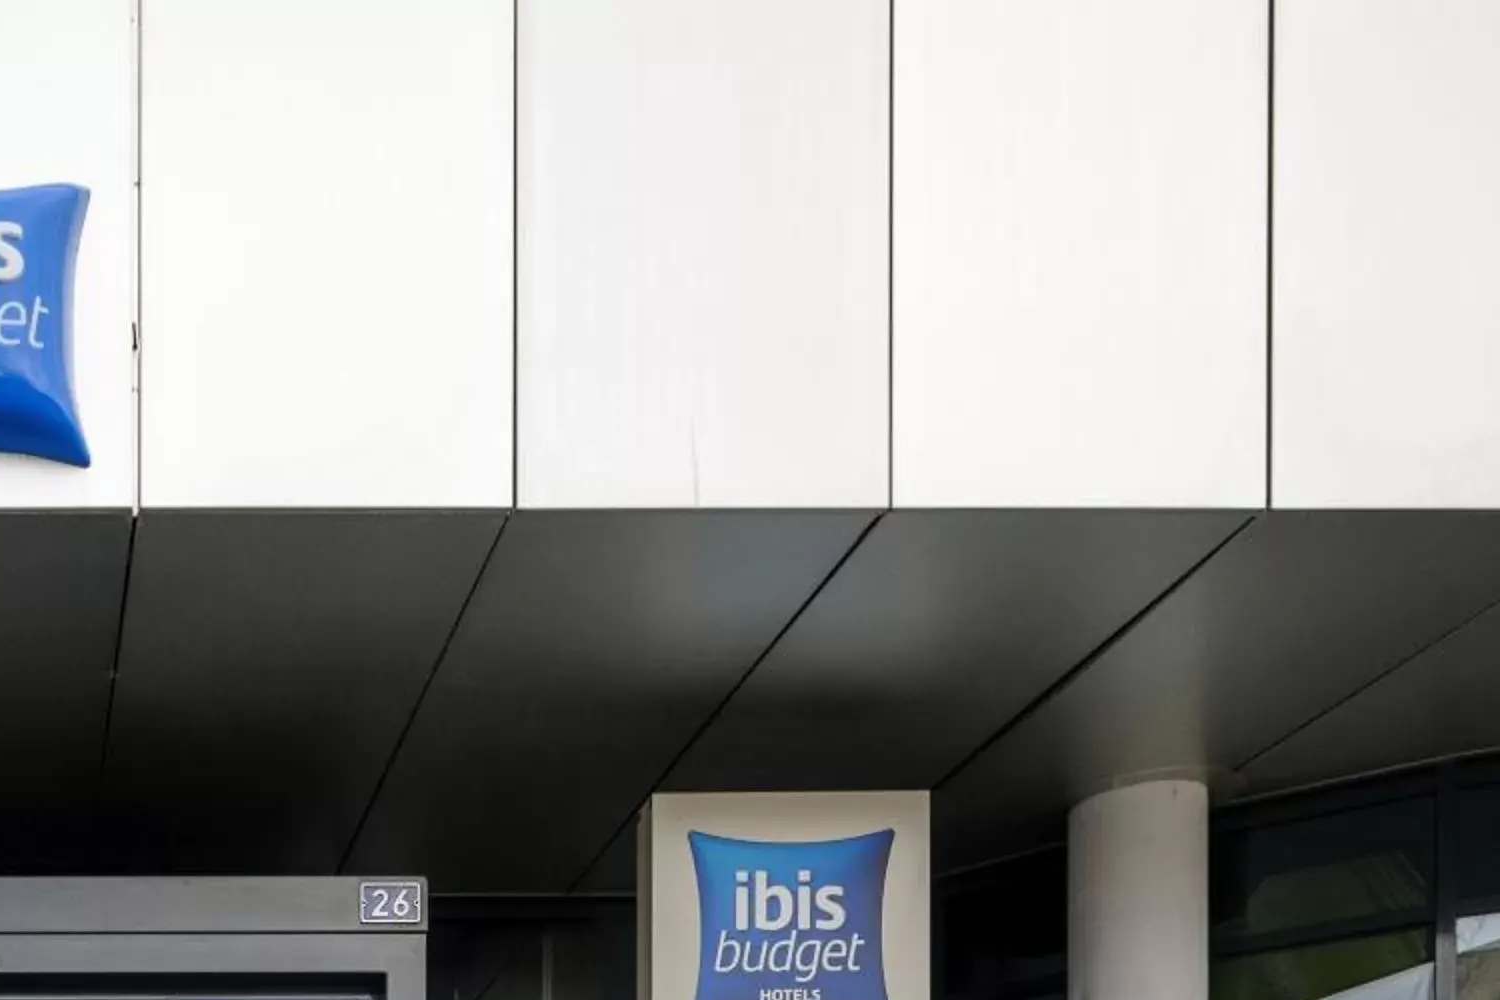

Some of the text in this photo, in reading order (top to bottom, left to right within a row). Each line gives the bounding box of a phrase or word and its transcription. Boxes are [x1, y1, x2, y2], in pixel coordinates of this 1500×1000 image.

[371, 888, 410, 917] 26
[734, 869, 847, 931] ibis
[713, 929, 866, 983] budget
